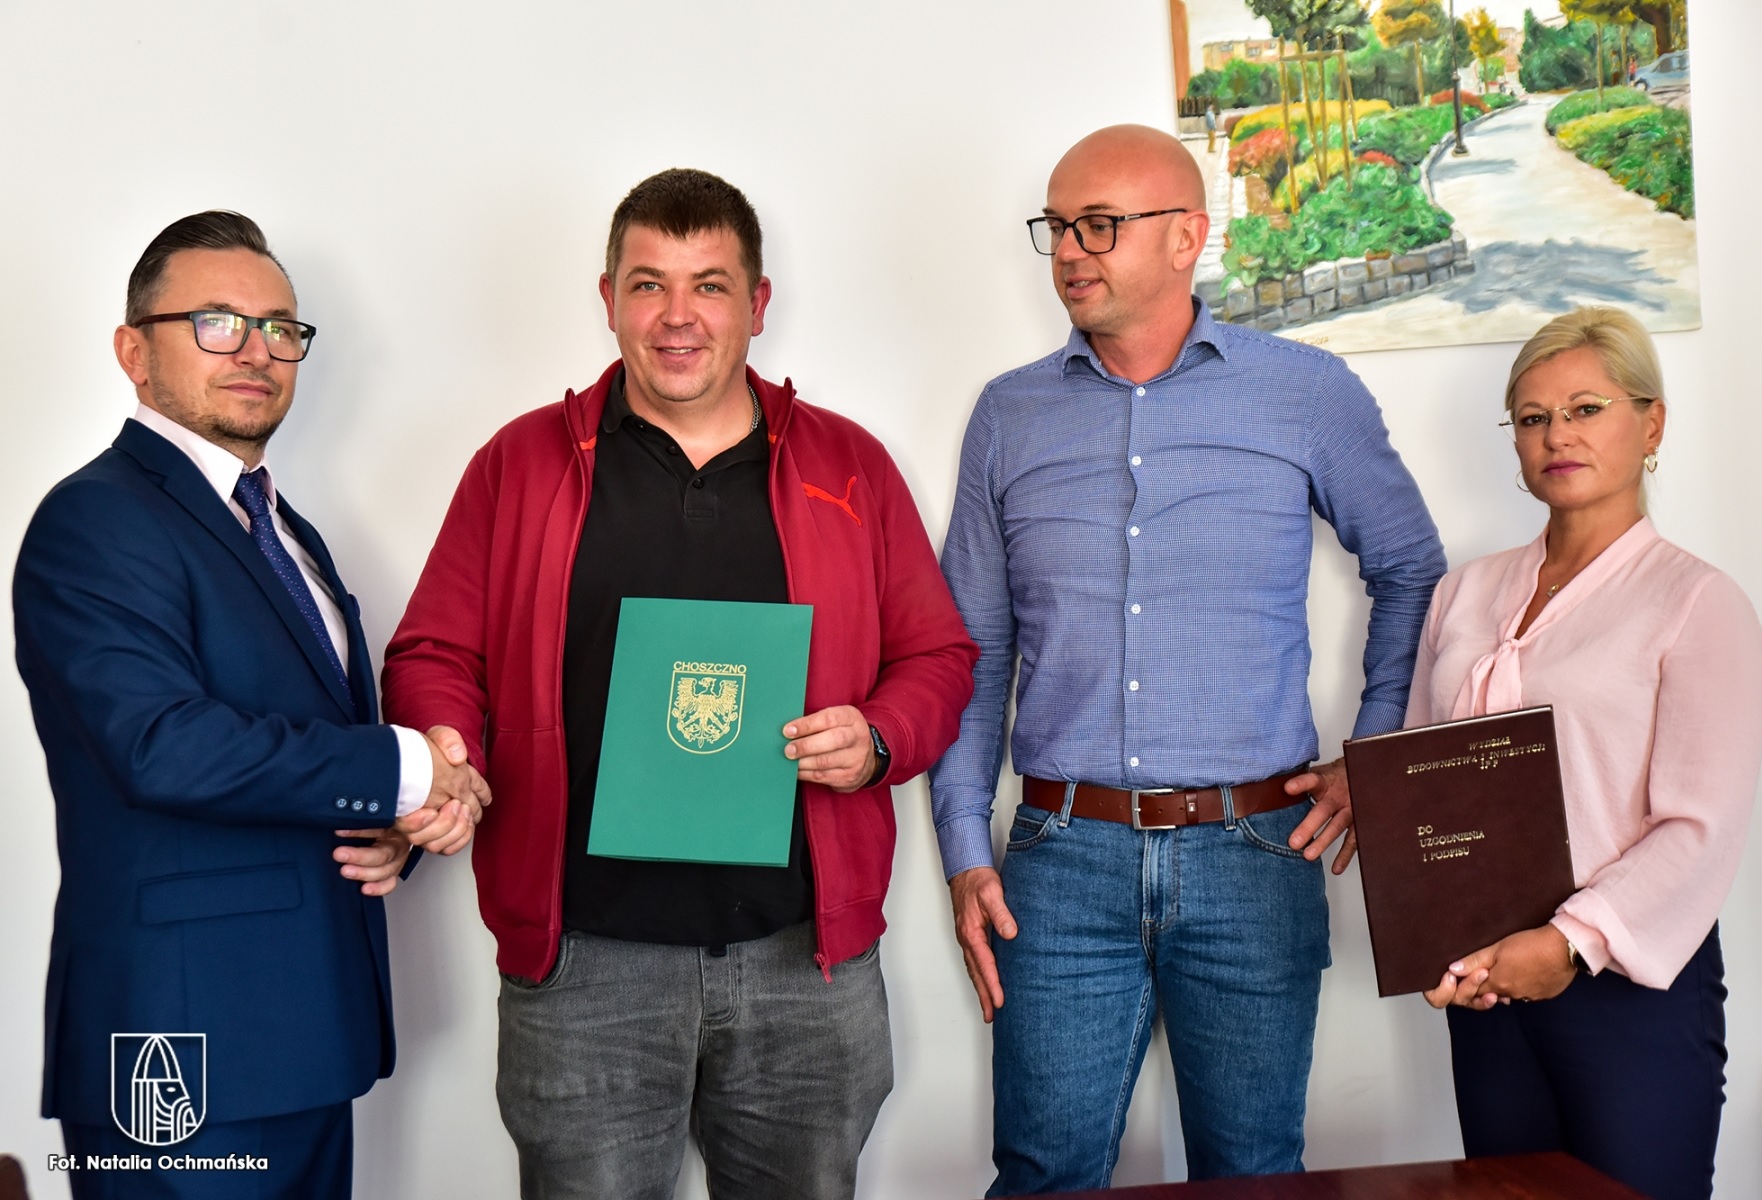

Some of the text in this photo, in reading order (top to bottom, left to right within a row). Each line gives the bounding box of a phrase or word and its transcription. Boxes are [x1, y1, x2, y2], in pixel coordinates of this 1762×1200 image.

[673, 661, 747, 674] CHOSZCZNO
[1406, 755, 1478, 774] BUDOWNICTWA
[1417, 825, 1434, 836] DO
[1430, 846, 1470, 861] PODPISU
